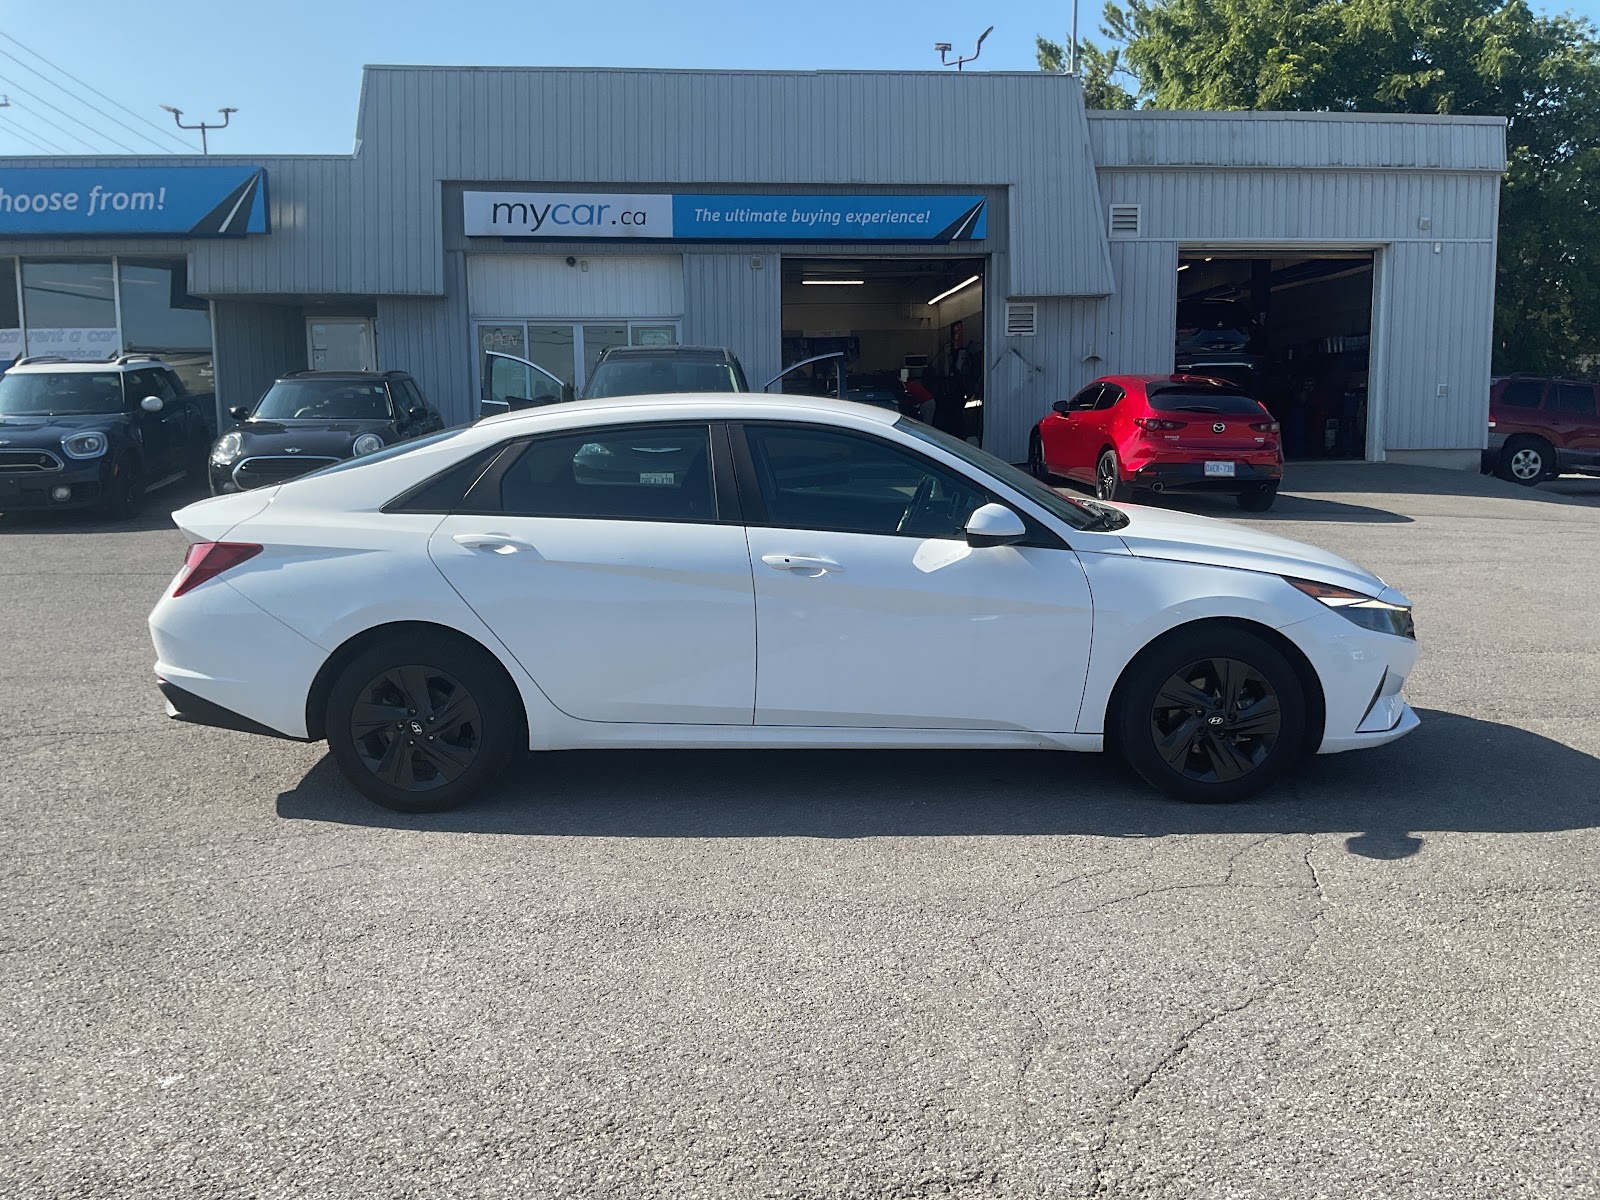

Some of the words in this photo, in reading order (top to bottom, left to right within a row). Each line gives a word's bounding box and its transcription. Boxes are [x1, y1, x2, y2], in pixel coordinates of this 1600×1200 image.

[87, 185, 166, 216] from!
[492, 202, 647, 232] mycar.ca
[694, 208, 721, 223] The
[725, 209, 787, 223] ultimate
[792, 209, 841, 226] buying
[845, 210, 931, 226] experience!
[27, 328, 65, 343] rent
[69, 331, 82, 343] a
[87, 331, 118, 343] car
[483, 333, 518, 346] OPEN
